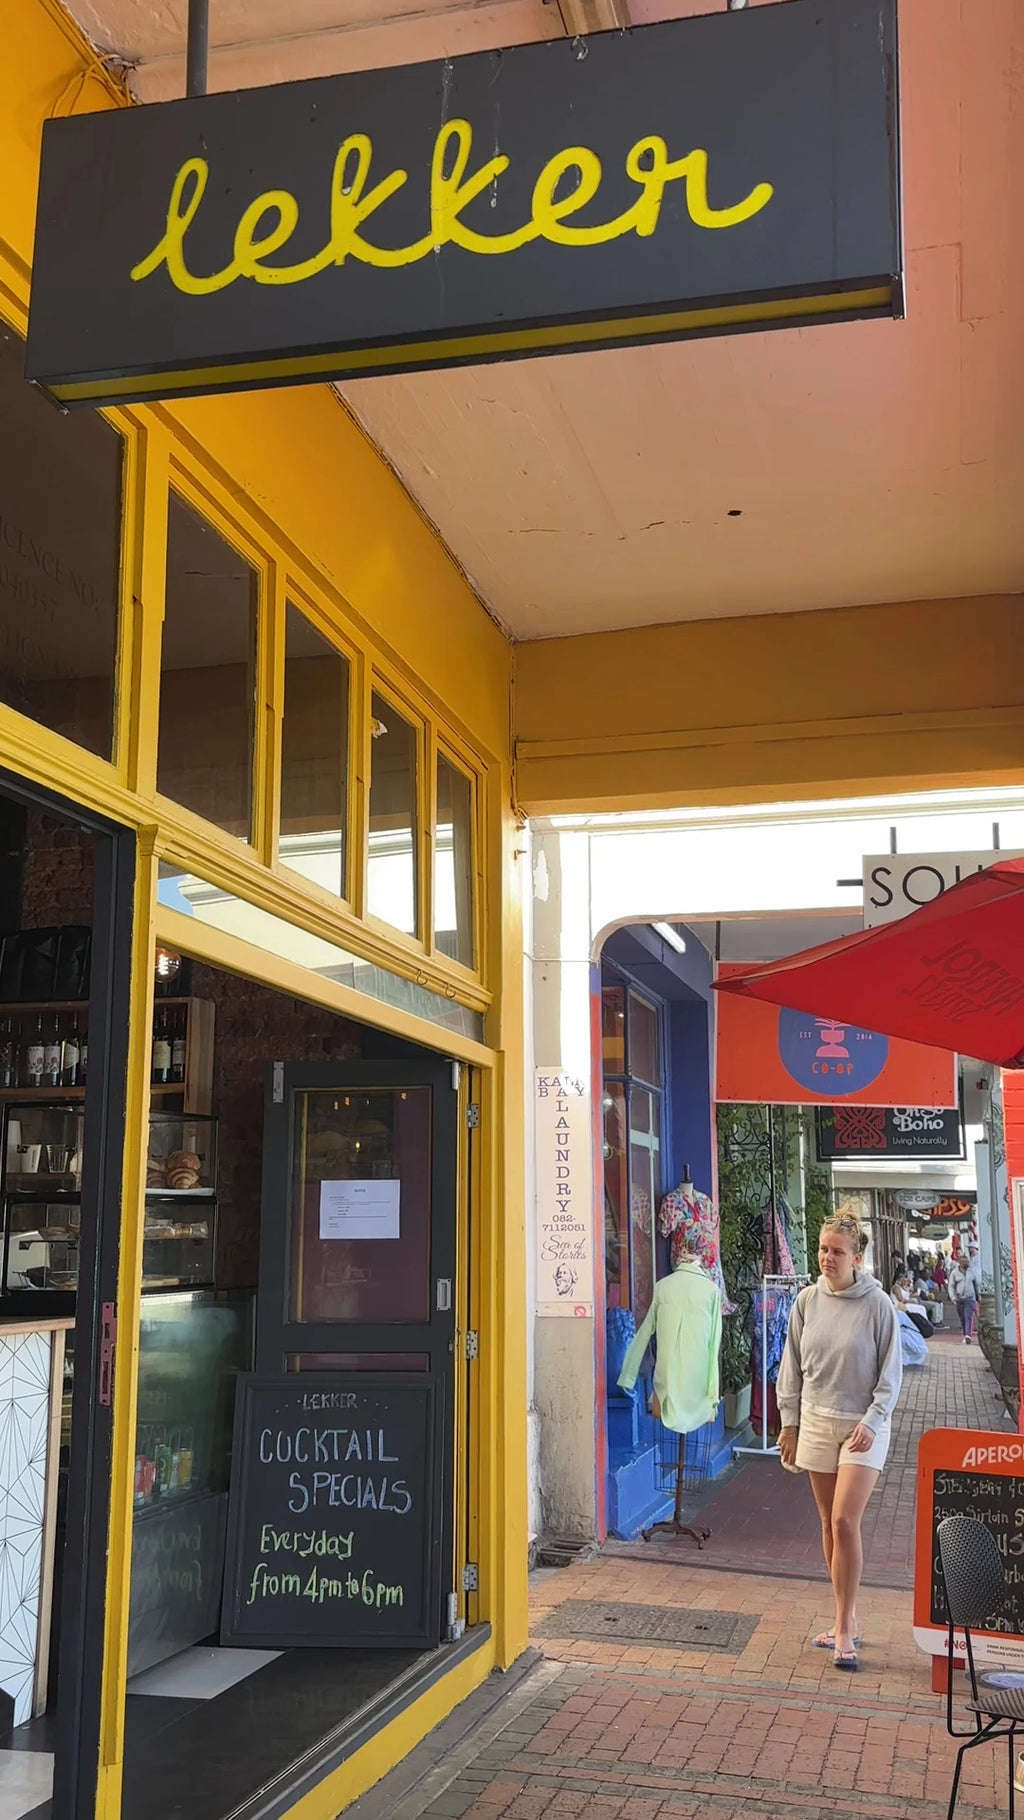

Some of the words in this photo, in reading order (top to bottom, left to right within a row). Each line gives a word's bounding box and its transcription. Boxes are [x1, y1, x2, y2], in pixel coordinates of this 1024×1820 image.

[130, 118, 774, 295] lekker
[870, 865, 982, 907] SO
[811, 1062, 853, 1075] CO-OP
[893, 1114, 944, 1132] Boho
[892, 1136, 912, 1146] Living
[913, 1135, 948, 1146] Naturally
[555, 1100, 571, 1212] LAUNDRY
[542, 1224, 586, 1232] 7112051
[541, 1245, 587, 1262] Stories
[303, 1393, 358, 1409] LEKKER
[259, 1428, 399, 1463] COCKTAIL
[963, 1446, 1024, 1468] APERO
[288, 1472, 412, 1514] SPECIALS
[260, 1524, 354, 1560] Everyday
[247, 1563, 301, 1605] from
